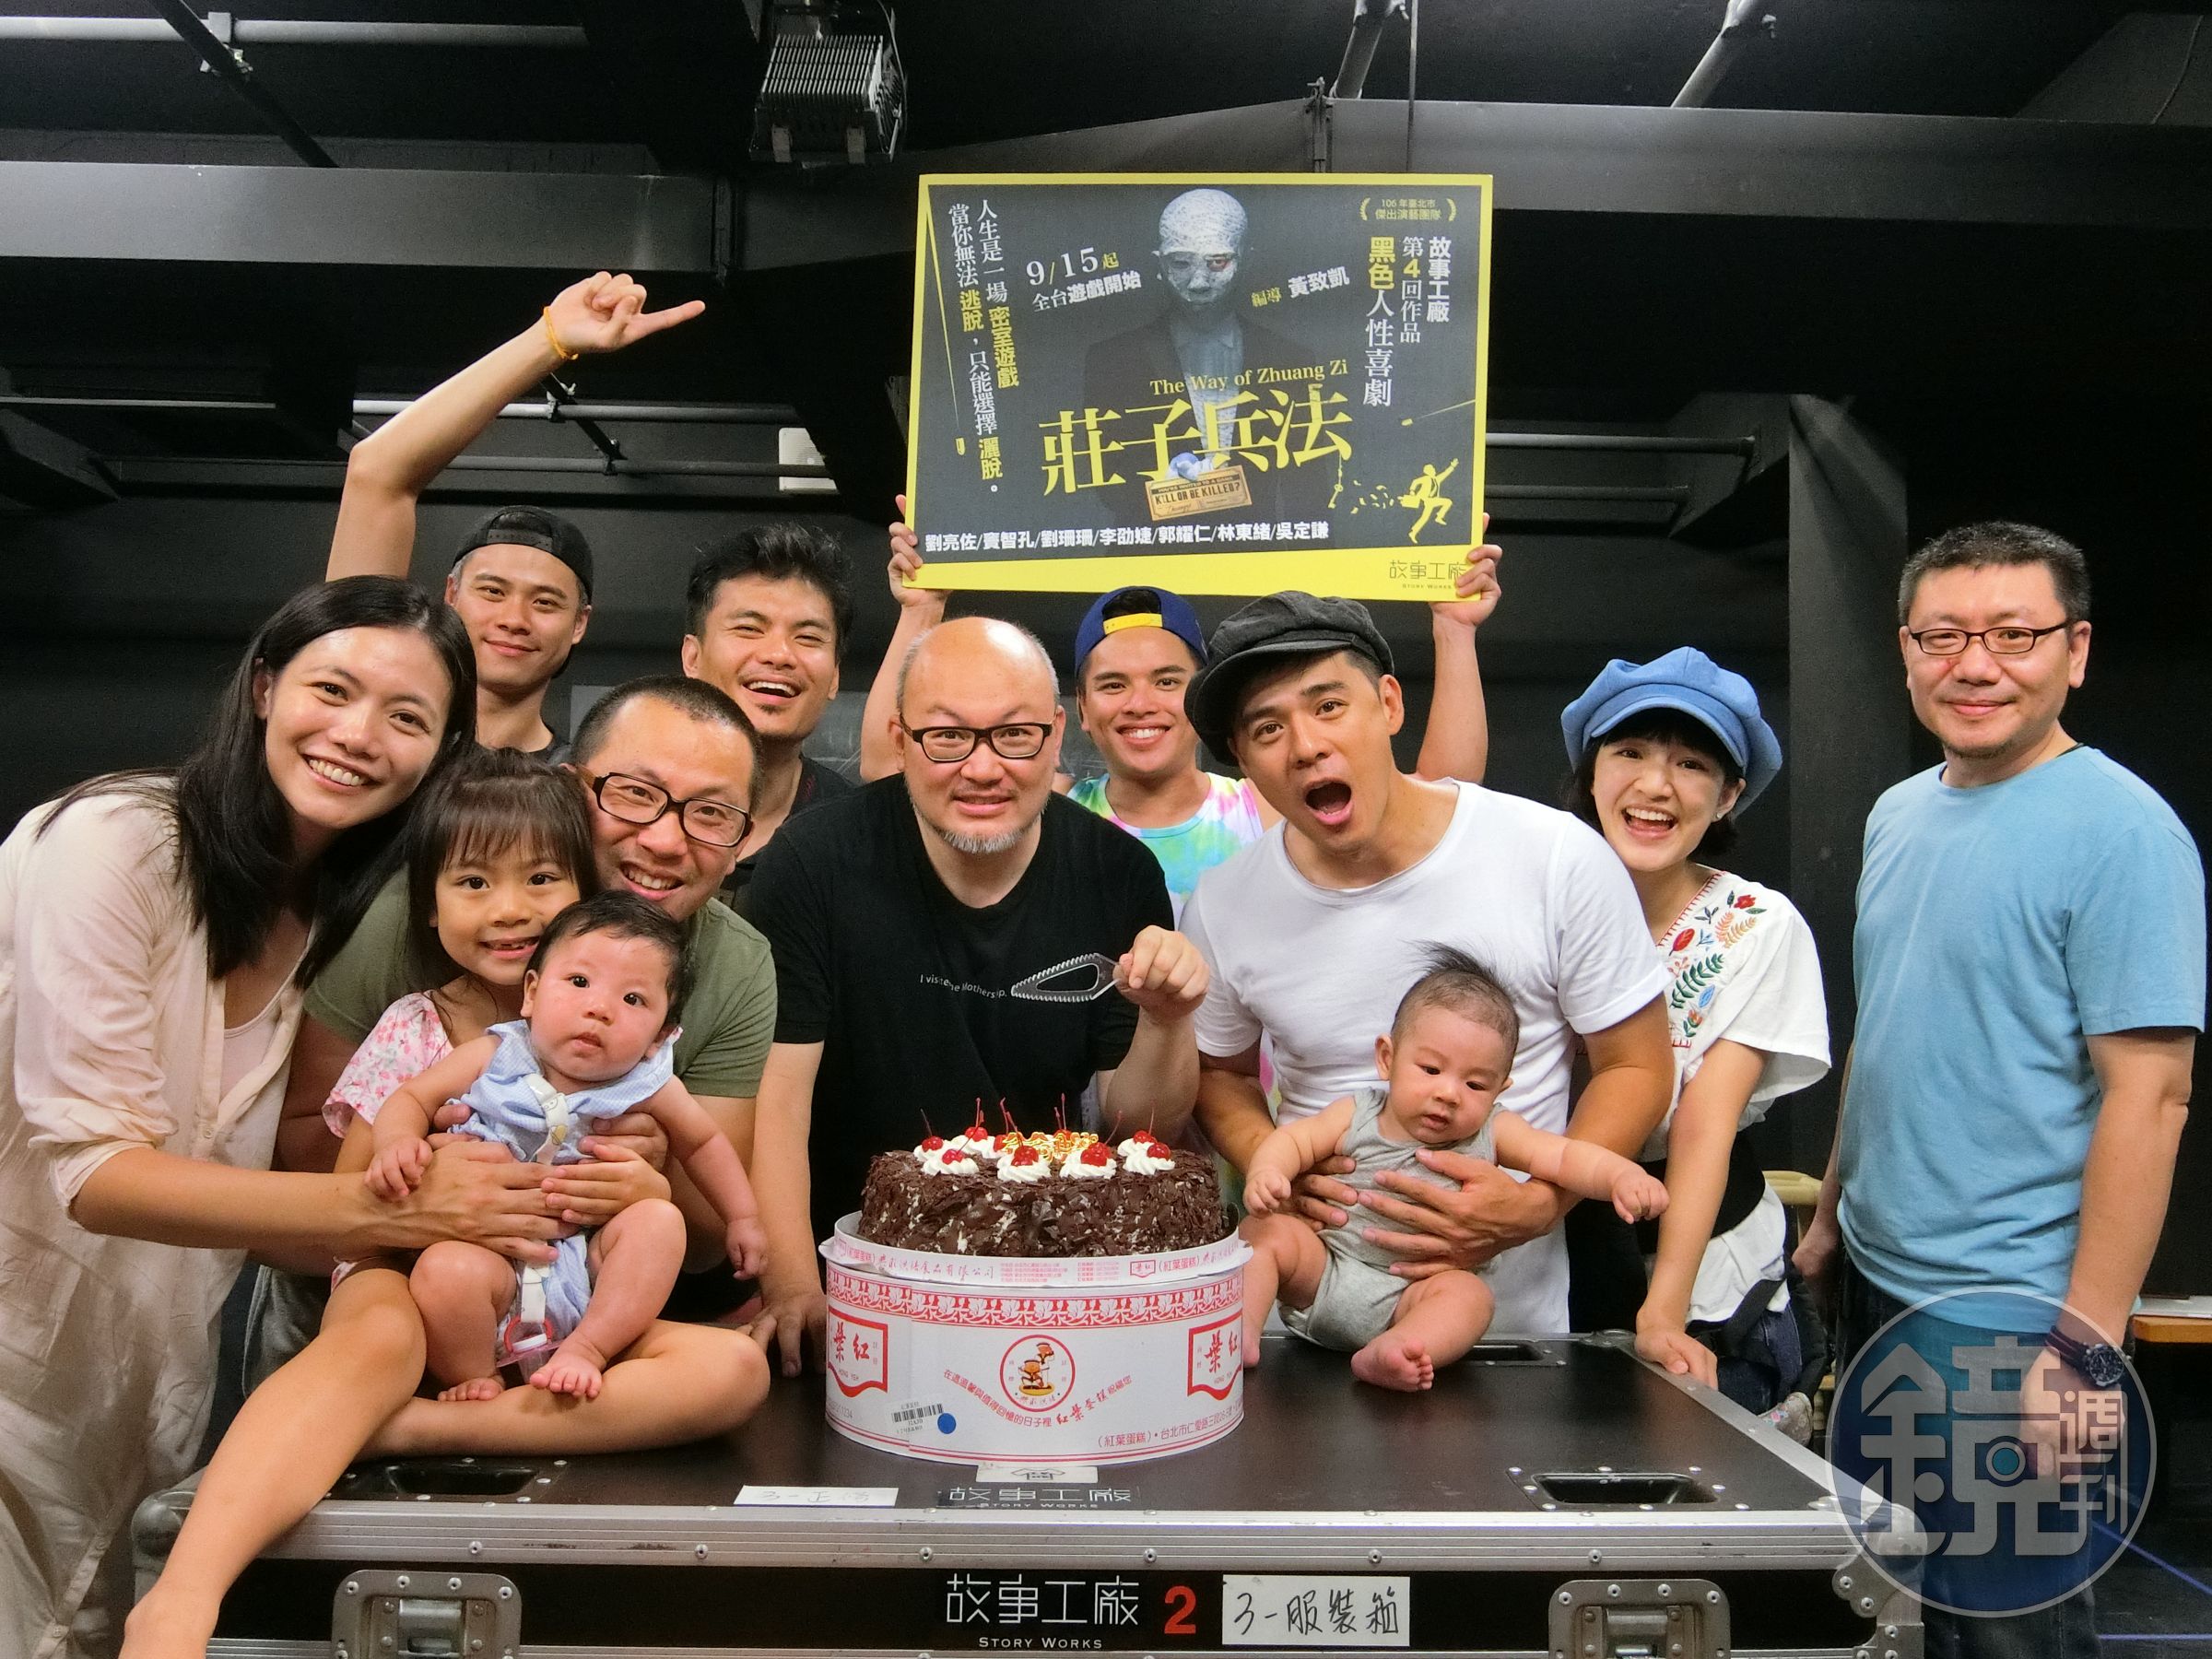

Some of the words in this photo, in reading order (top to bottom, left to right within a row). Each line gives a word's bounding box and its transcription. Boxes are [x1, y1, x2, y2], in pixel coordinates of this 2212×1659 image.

[1031, 270, 1142, 312] 全台遊戲開始
[1288, 265, 1350, 300] 黃致凱
[1400, 237, 1423, 344] 第4回作品
[1427, 236, 1452, 323] 故事工廠
[1362, 236, 1395, 407] 黑色人性喜劇
[1150, 379, 1184, 396] The
[1189, 373, 1228, 392] Way
[1234, 368, 1252, 385] of
[1257, 363, 1325, 384] Zhuang
[1330, 359, 1348, 375] Zi
[1039, 383, 1353, 496] 莊子兵法
[949, 1487, 1132, 1502] 故事工廠
[947, 1572, 1139, 1625] 故事工廠
[1164, 1585, 1196, 1634] 2
